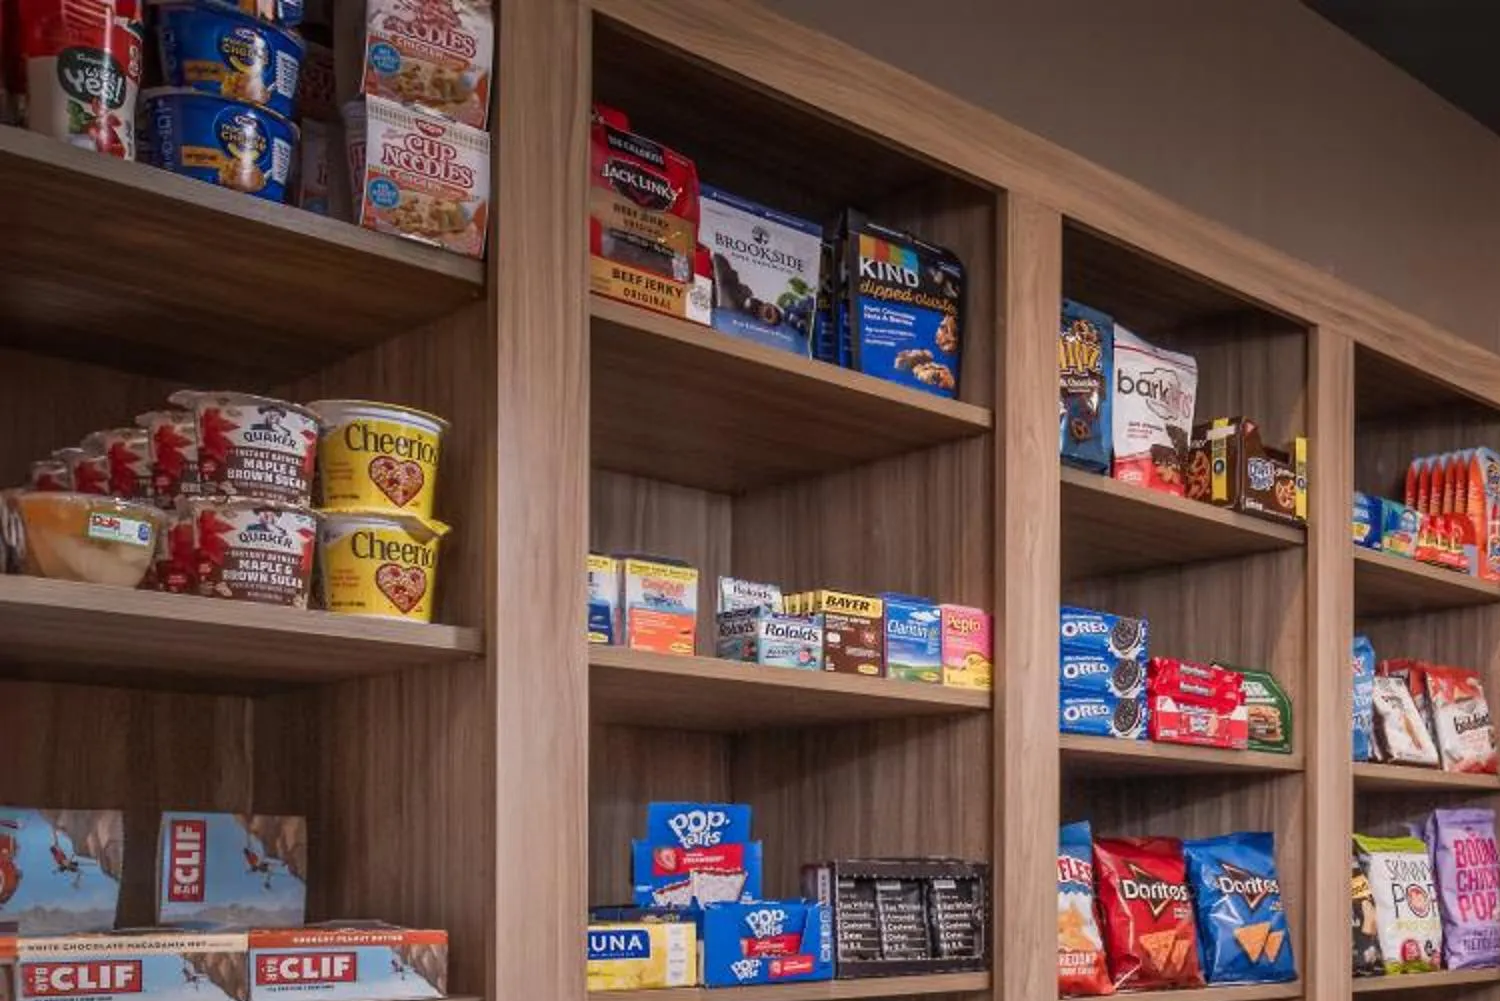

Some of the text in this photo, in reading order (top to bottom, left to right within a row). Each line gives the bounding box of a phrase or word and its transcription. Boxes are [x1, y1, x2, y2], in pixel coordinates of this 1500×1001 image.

[404, 134, 457, 161] CUP
[381, 145, 475, 189] NOODLES
[602, 163, 639, 186] JACK
[715, 231, 804, 273] BROOKSIDE
[612, 268, 684, 298] BEEF JERKY
[858, 256, 919, 289] KIND
[623, 287, 673, 310] ORIGINAL
[859, 278, 912, 301] dipped
[243, 431, 297, 449] QUAKER
[227, 469, 274, 483] BROWN
[243, 458, 287, 474] MAPLE
[238, 532, 294, 549] QUAKER
[351, 531, 435, 569] Cheerio
[222, 570, 269, 583] BROWN
[239, 559, 283, 573] MAPLE
[826, 595, 871, 612] BAYER
[764, 621, 819, 642] Rolaids
[1061, 621, 1110, 638] OREO
[1063, 662, 1110, 679] OREO
[1063, 704, 1110, 721] OREO
[172, 824, 204, 885] CLIF
[1454, 837, 1500, 869] BOOM
[1058, 856, 1093, 884] FLES
[1122, 878, 1189, 902] Doritos
[1219, 876, 1280, 896] Doritos
[1457, 891, 1497, 922] POP
[588, 935, 644, 952] UNA
[51, 965, 135, 992] CLIF
[279, 955, 351, 980] CLIF
